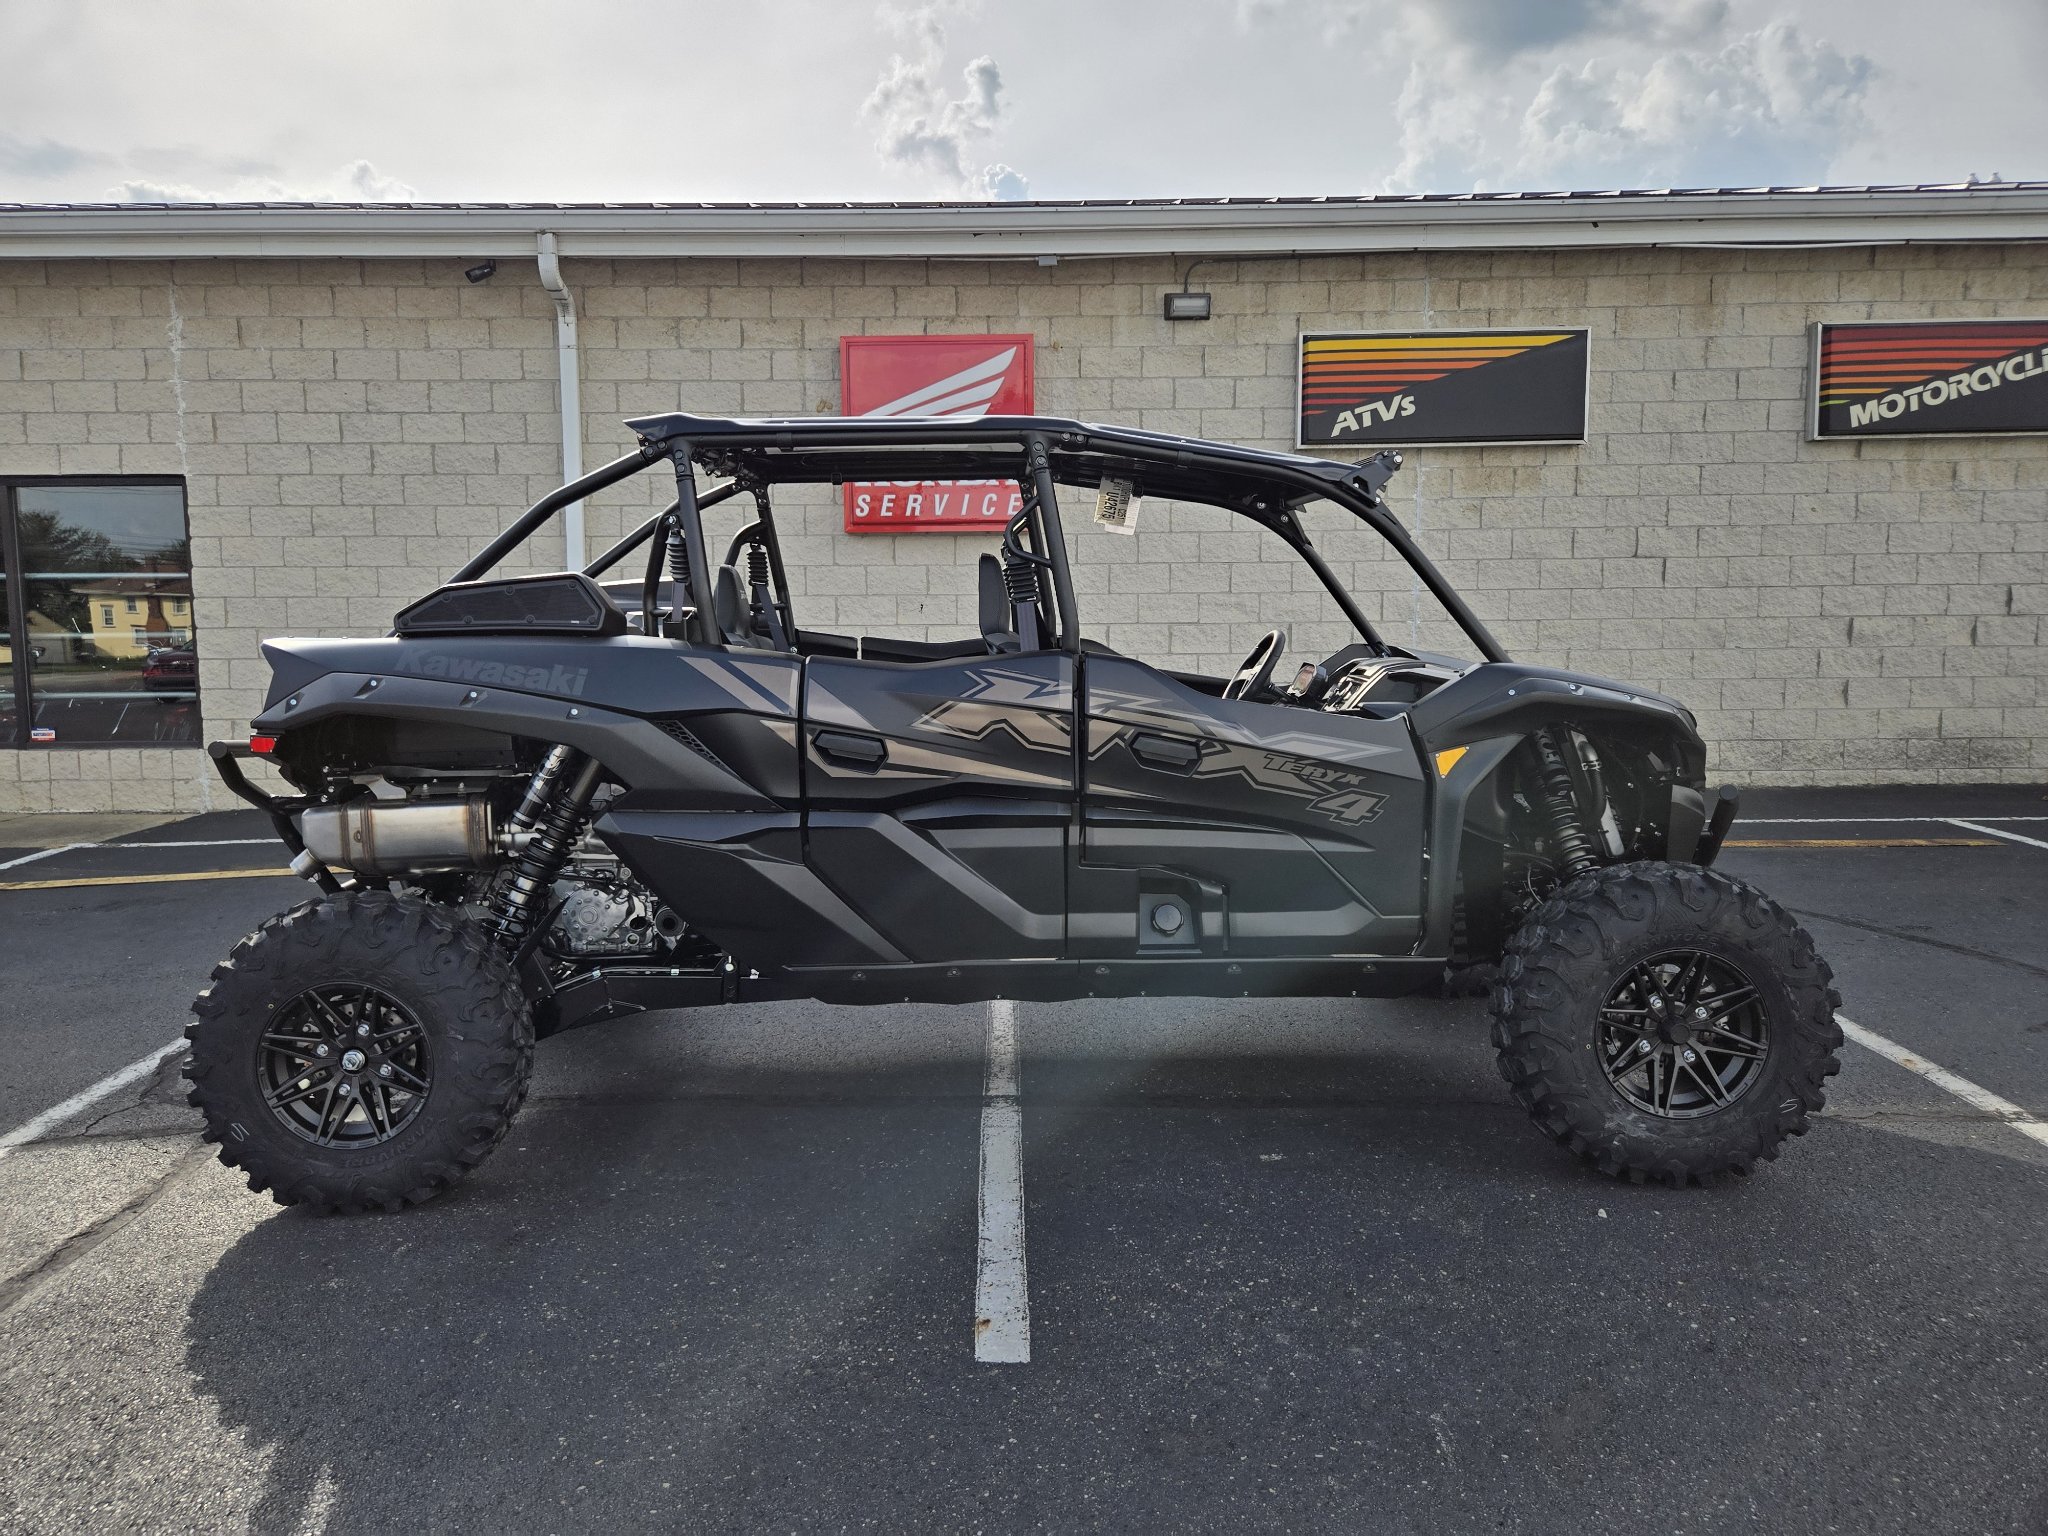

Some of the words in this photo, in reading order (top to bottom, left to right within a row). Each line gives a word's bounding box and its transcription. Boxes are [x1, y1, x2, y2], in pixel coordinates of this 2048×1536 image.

[855, 493, 1023, 518] SERVICE
[394, 649, 588, 696] Kawasaki
[1311, 790, 1385, 824] 4
